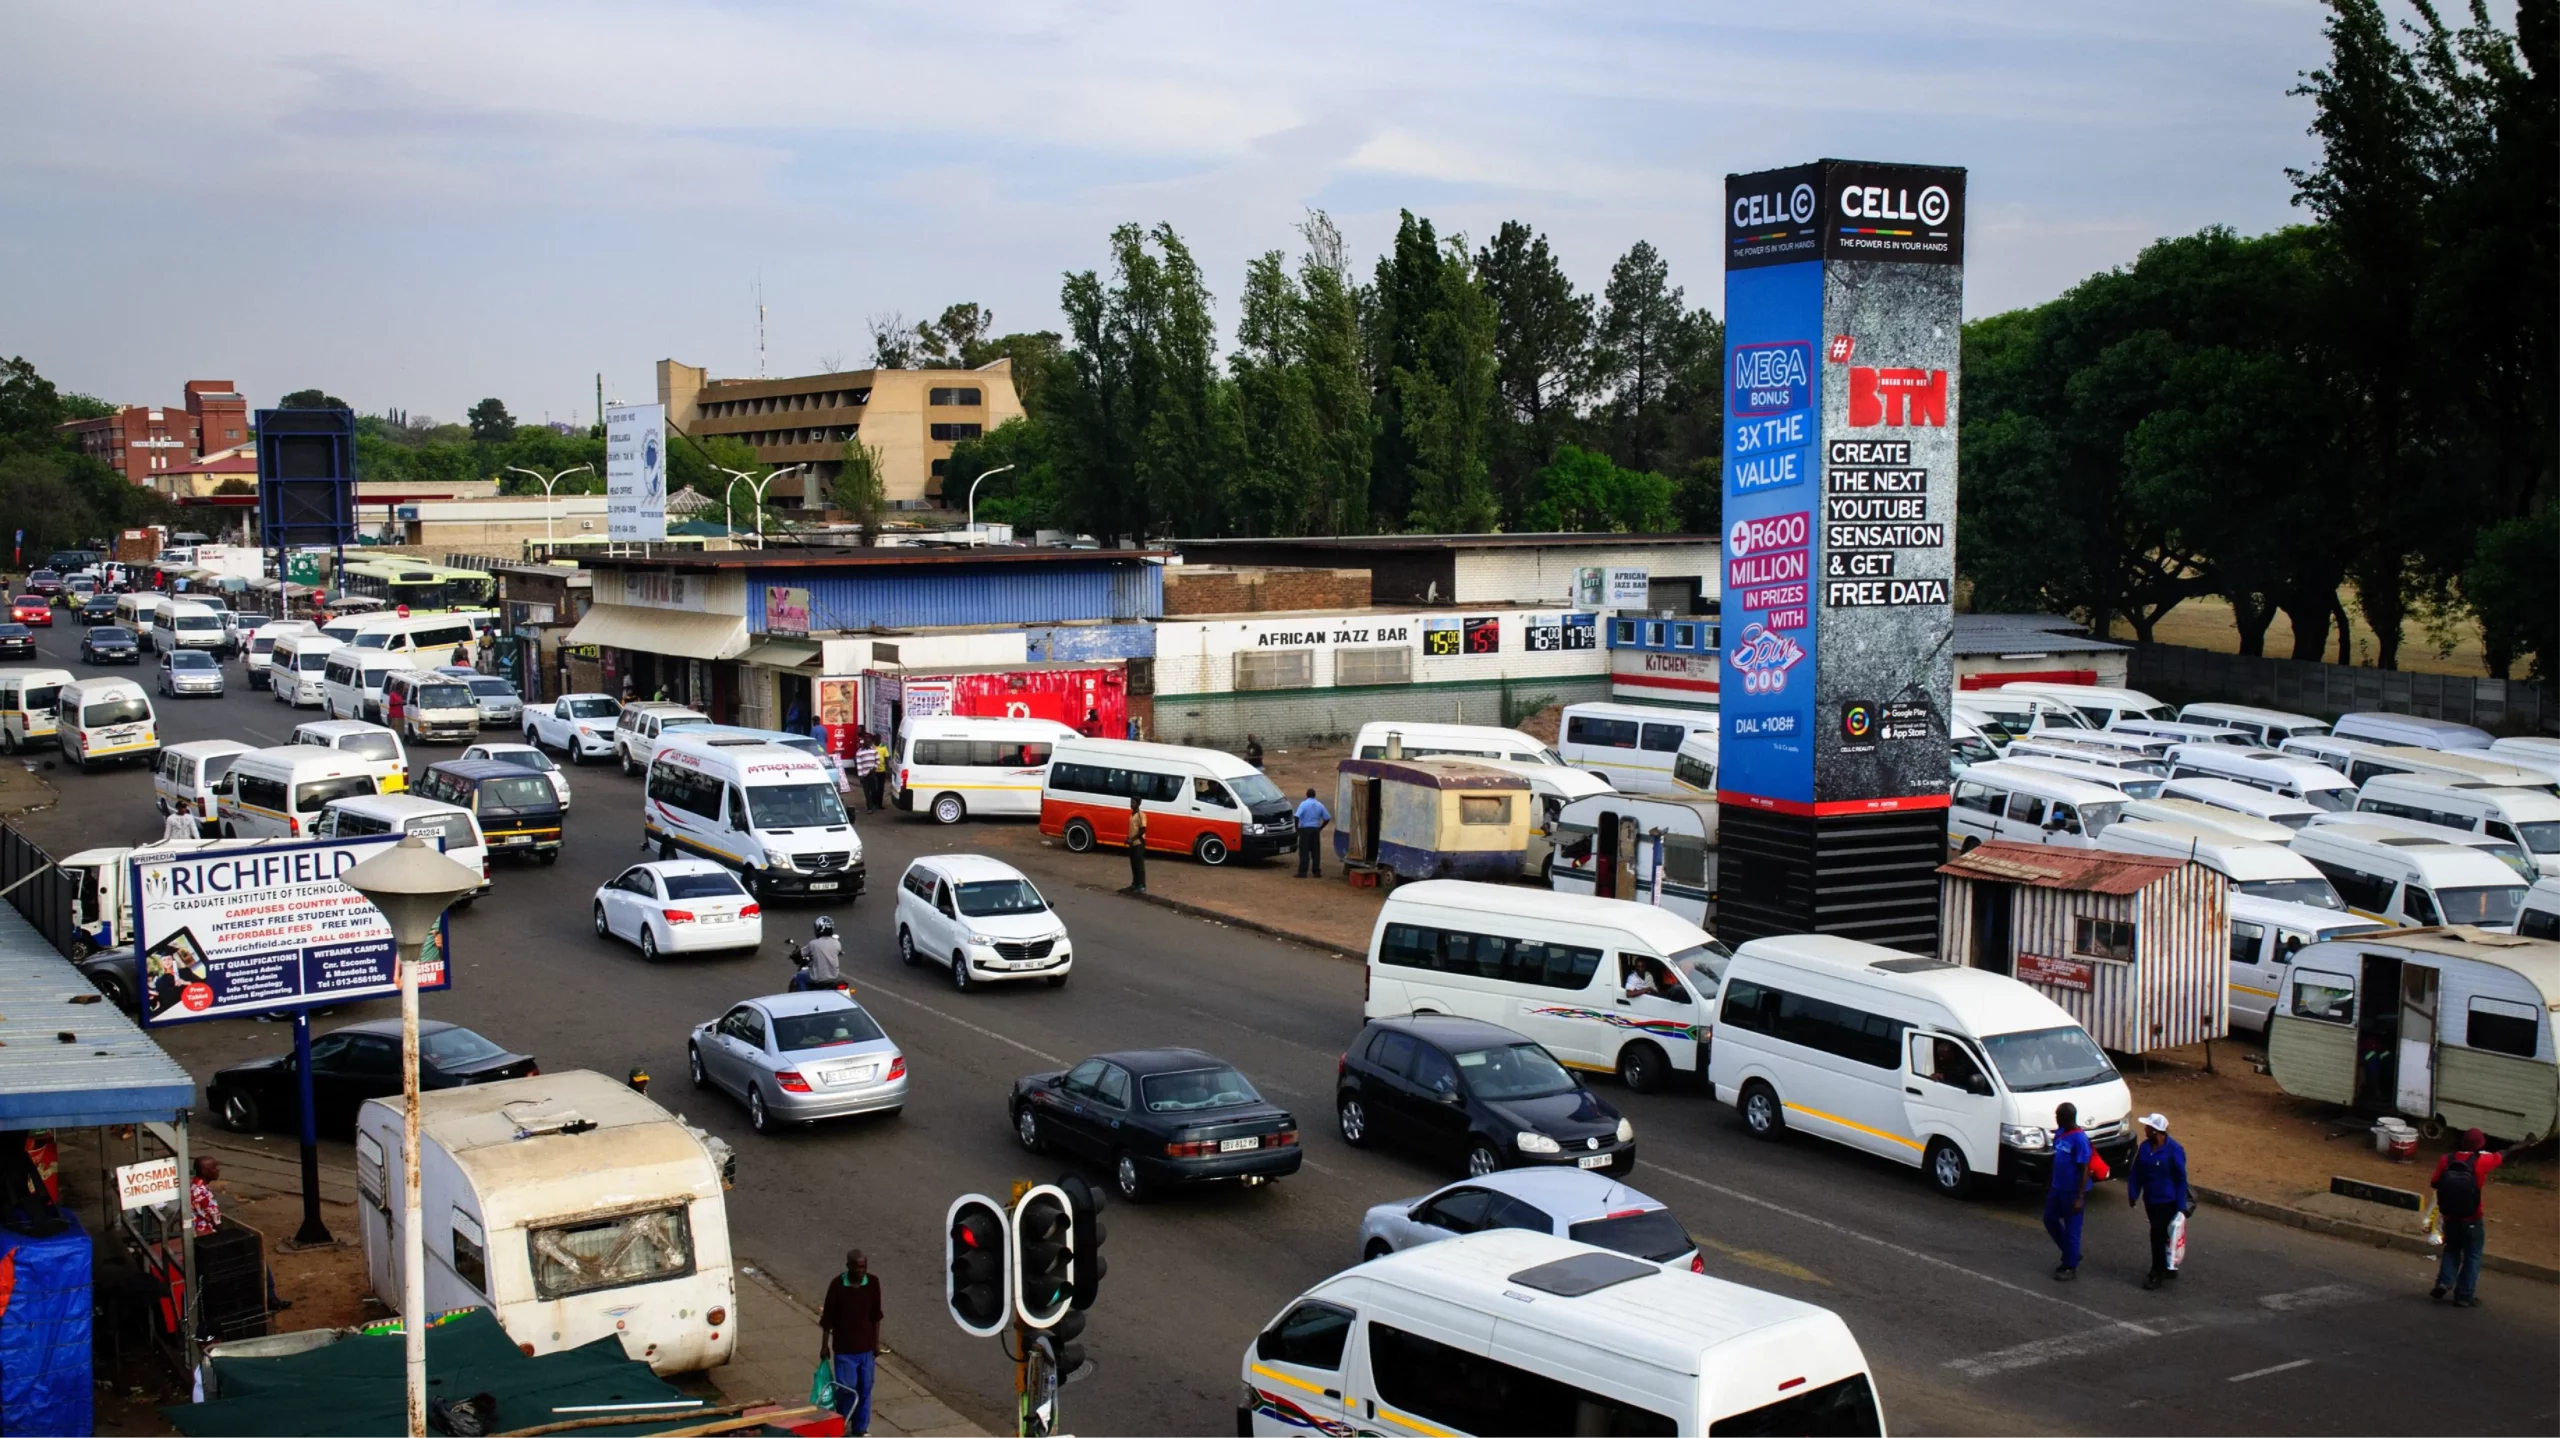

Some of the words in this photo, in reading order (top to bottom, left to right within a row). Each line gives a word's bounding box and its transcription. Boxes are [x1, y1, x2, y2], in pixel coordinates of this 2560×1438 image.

[1733, 192, 1790, 227] CELL
[1841, 185, 1917, 220] CELL
[1733, 248, 1744, 257] THE
[1744, 246, 1764, 256] POWER
[1765, 245, 1770, 253] IS
[1771, 244, 1778, 252] IN
[1777, 242, 1793, 252] YOUR
[1794, 240, 1815, 249] HANDS
[1840, 238, 1854, 247] THE
[1855, 239, 1882, 248] POWER
[1884, 241, 1891, 249] IS
[1892, 241, 1899, 249] IN
[1901, 242, 1921, 250] YOUR
[1922, 243, 1948, 252] HANDS
[1833, 339, 1848, 359] #
[1736, 349, 1807, 389] MEGA
[1903, 378, 1914, 386] THE
[1751, 390, 1790, 406] BONUS
[1736, 423, 1761, 452] 3X
[1763, 414, 1803, 446] THE
[1831, 443, 1907, 463] CREATE
[1735, 453, 1797, 488] VALUE
[1831, 471, 1869, 491] THE
[1873, 471, 1925, 491] NEXT
[1830, 499, 1924, 519] YOUTUBE
[1830, 526, 1941, 546] SENSATION
[1732, 552, 1804, 586] MILLION
[1829, 554, 1846, 576] &
[1850, 554, 1892, 575] GET
[1614, 572, 1647, 580] AFRICAN
[1746, 591, 1758, 608] IN
[1761, 585, 1804, 606] PRIZES
[1829, 582, 1886, 606] FREE
[1890, 581, 1946, 604] DATA
[1771, 610, 1804, 628] WITH
[1258, 631, 1326, 646] AFRICAN
[1333, 629, 1369, 643] JAZZ
[1377, 627, 1407, 641] BAR
[1892, 709, 1913, 718] Google
[1913, 708, 1927, 717] Play
[1736, 719, 1760, 734] DIAL
[1893, 730, 1908, 739] App
[1908, 728, 1927, 737] Store
[134, 853, 175, 864] PRIMEDIA
[171, 850, 357, 896] RICHFIELD
[173, 896, 224, 910] GRADUATE
[227, 890, 277, 905] INSTITUTE
[280, 889, 293, 898] OF
[225, 903, 285, 918] CAMPUSES
[288, 898, 341, 911] COUNTRY
[342, 895, 368, 906] WIDE
[212, 918, 264, 931] INTEREST
[268, 913, 295, 925] FREE
[297, 909, 345, 920] STUDENT
[218, 925, 285, 943] AFFORDABLE
[287, 923, 313, 934] FEES
[322, 919, 348, 930] FREE
[350, 917, 373, 926] WIFI
[205, 936, 307, 956] www.richfield.ac.za
[311, 933, 336, 943] CALL
[338, 930, 361, 940] 0861
[364, 928, 381, 937] 321
[314, 948, 352, 959] WITBANK
[354, 943, 389, 954] CAMPUS
[209, 962, 225, 972] FET
[227, 953, 298, 969] QUALIFICATIONS
[225, 968, 259, 978] Business
[260, 964, 283, 973] Admin
[322, 961, 339, 970] Cnr.
[340, 958, 377, 968] Escombe
[334, 967, 367, 977] Mandela
[369, 966, 378, 974] St
[226, 985, 242, 993] Info
[242, 980, 283, 992] Technology
[231, 976, 254, 985] Office
[255, 973, 278, 982] Admin
[317, 980, 330, 988] Tel
[336, 973, 387, 987] 013-6561906
[218, 992, 249, 1003] Systems
[250, 986, 293, 998] Engineering
[126, 1166, 177, 1185] VOSMAN
[123, 1178, 181, 1197] SINQOBILE
